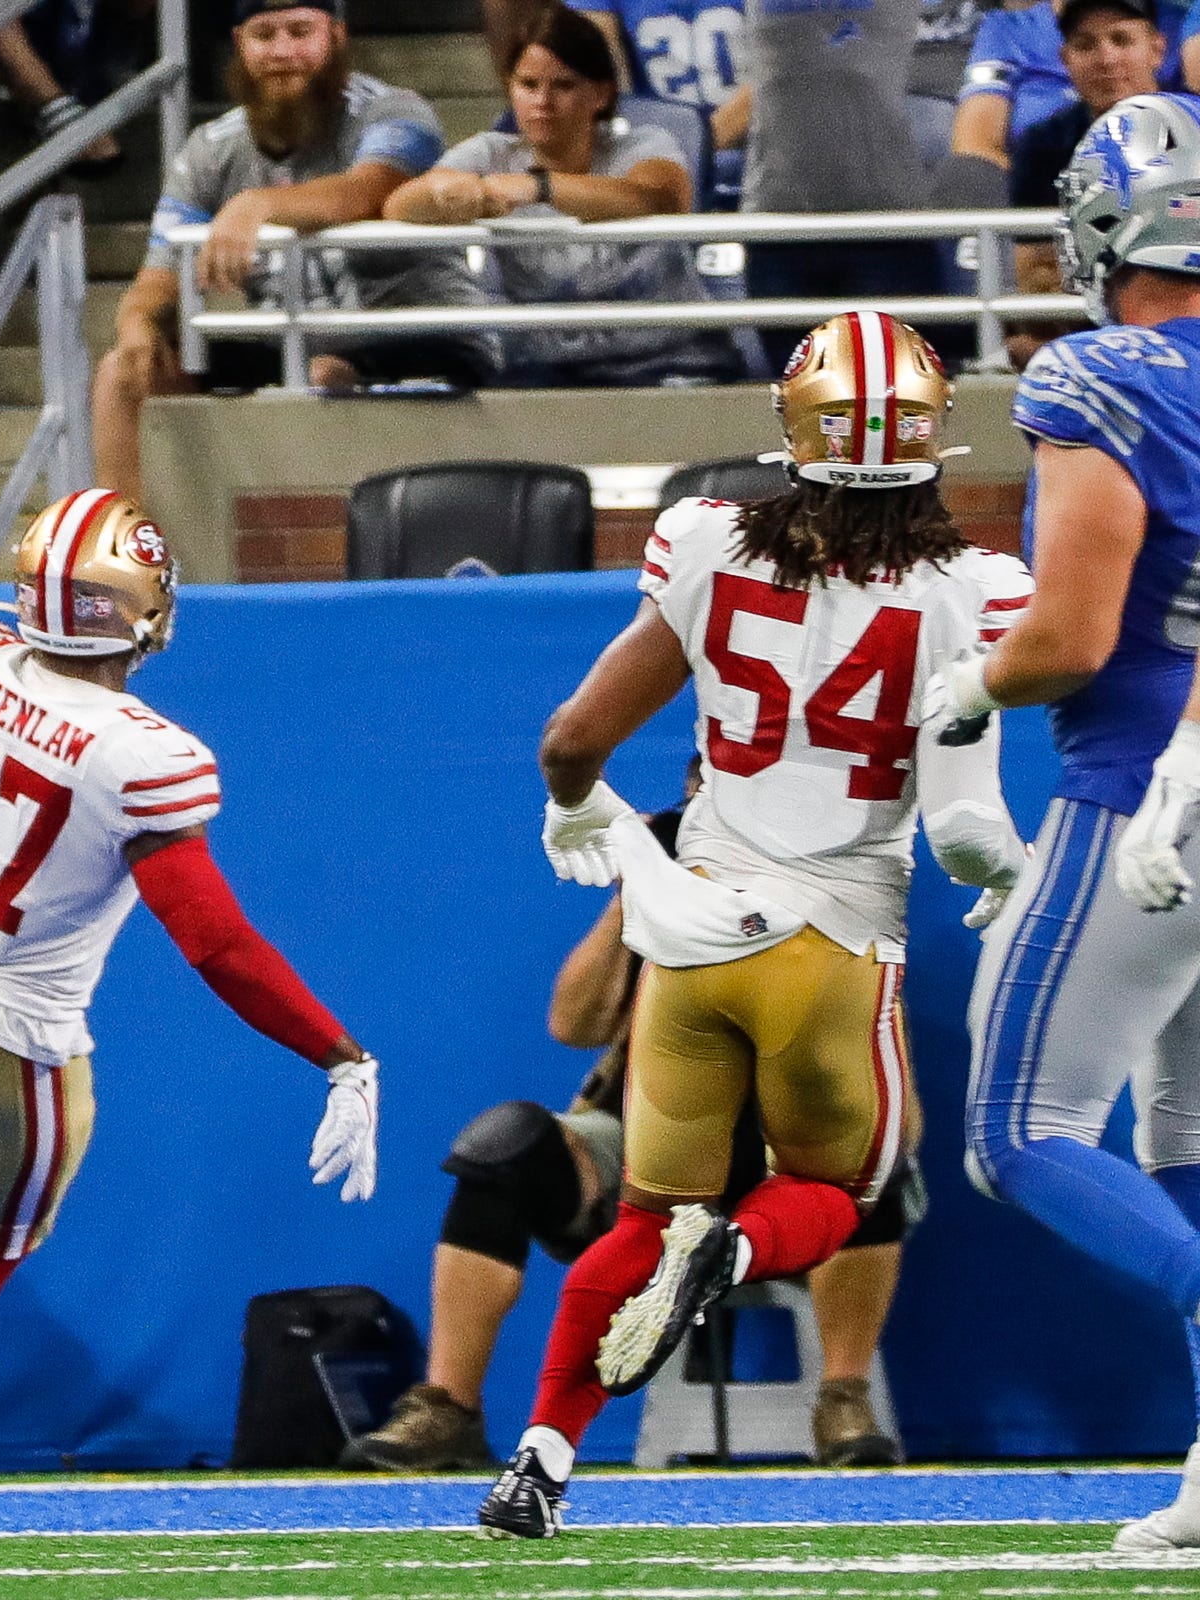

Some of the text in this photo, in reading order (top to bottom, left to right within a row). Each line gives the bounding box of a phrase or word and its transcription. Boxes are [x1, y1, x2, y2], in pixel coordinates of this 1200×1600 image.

[638, 8, 748, 104] 20
[829, 471, 856, 481] END
[704, 570, 923, 801] 54
